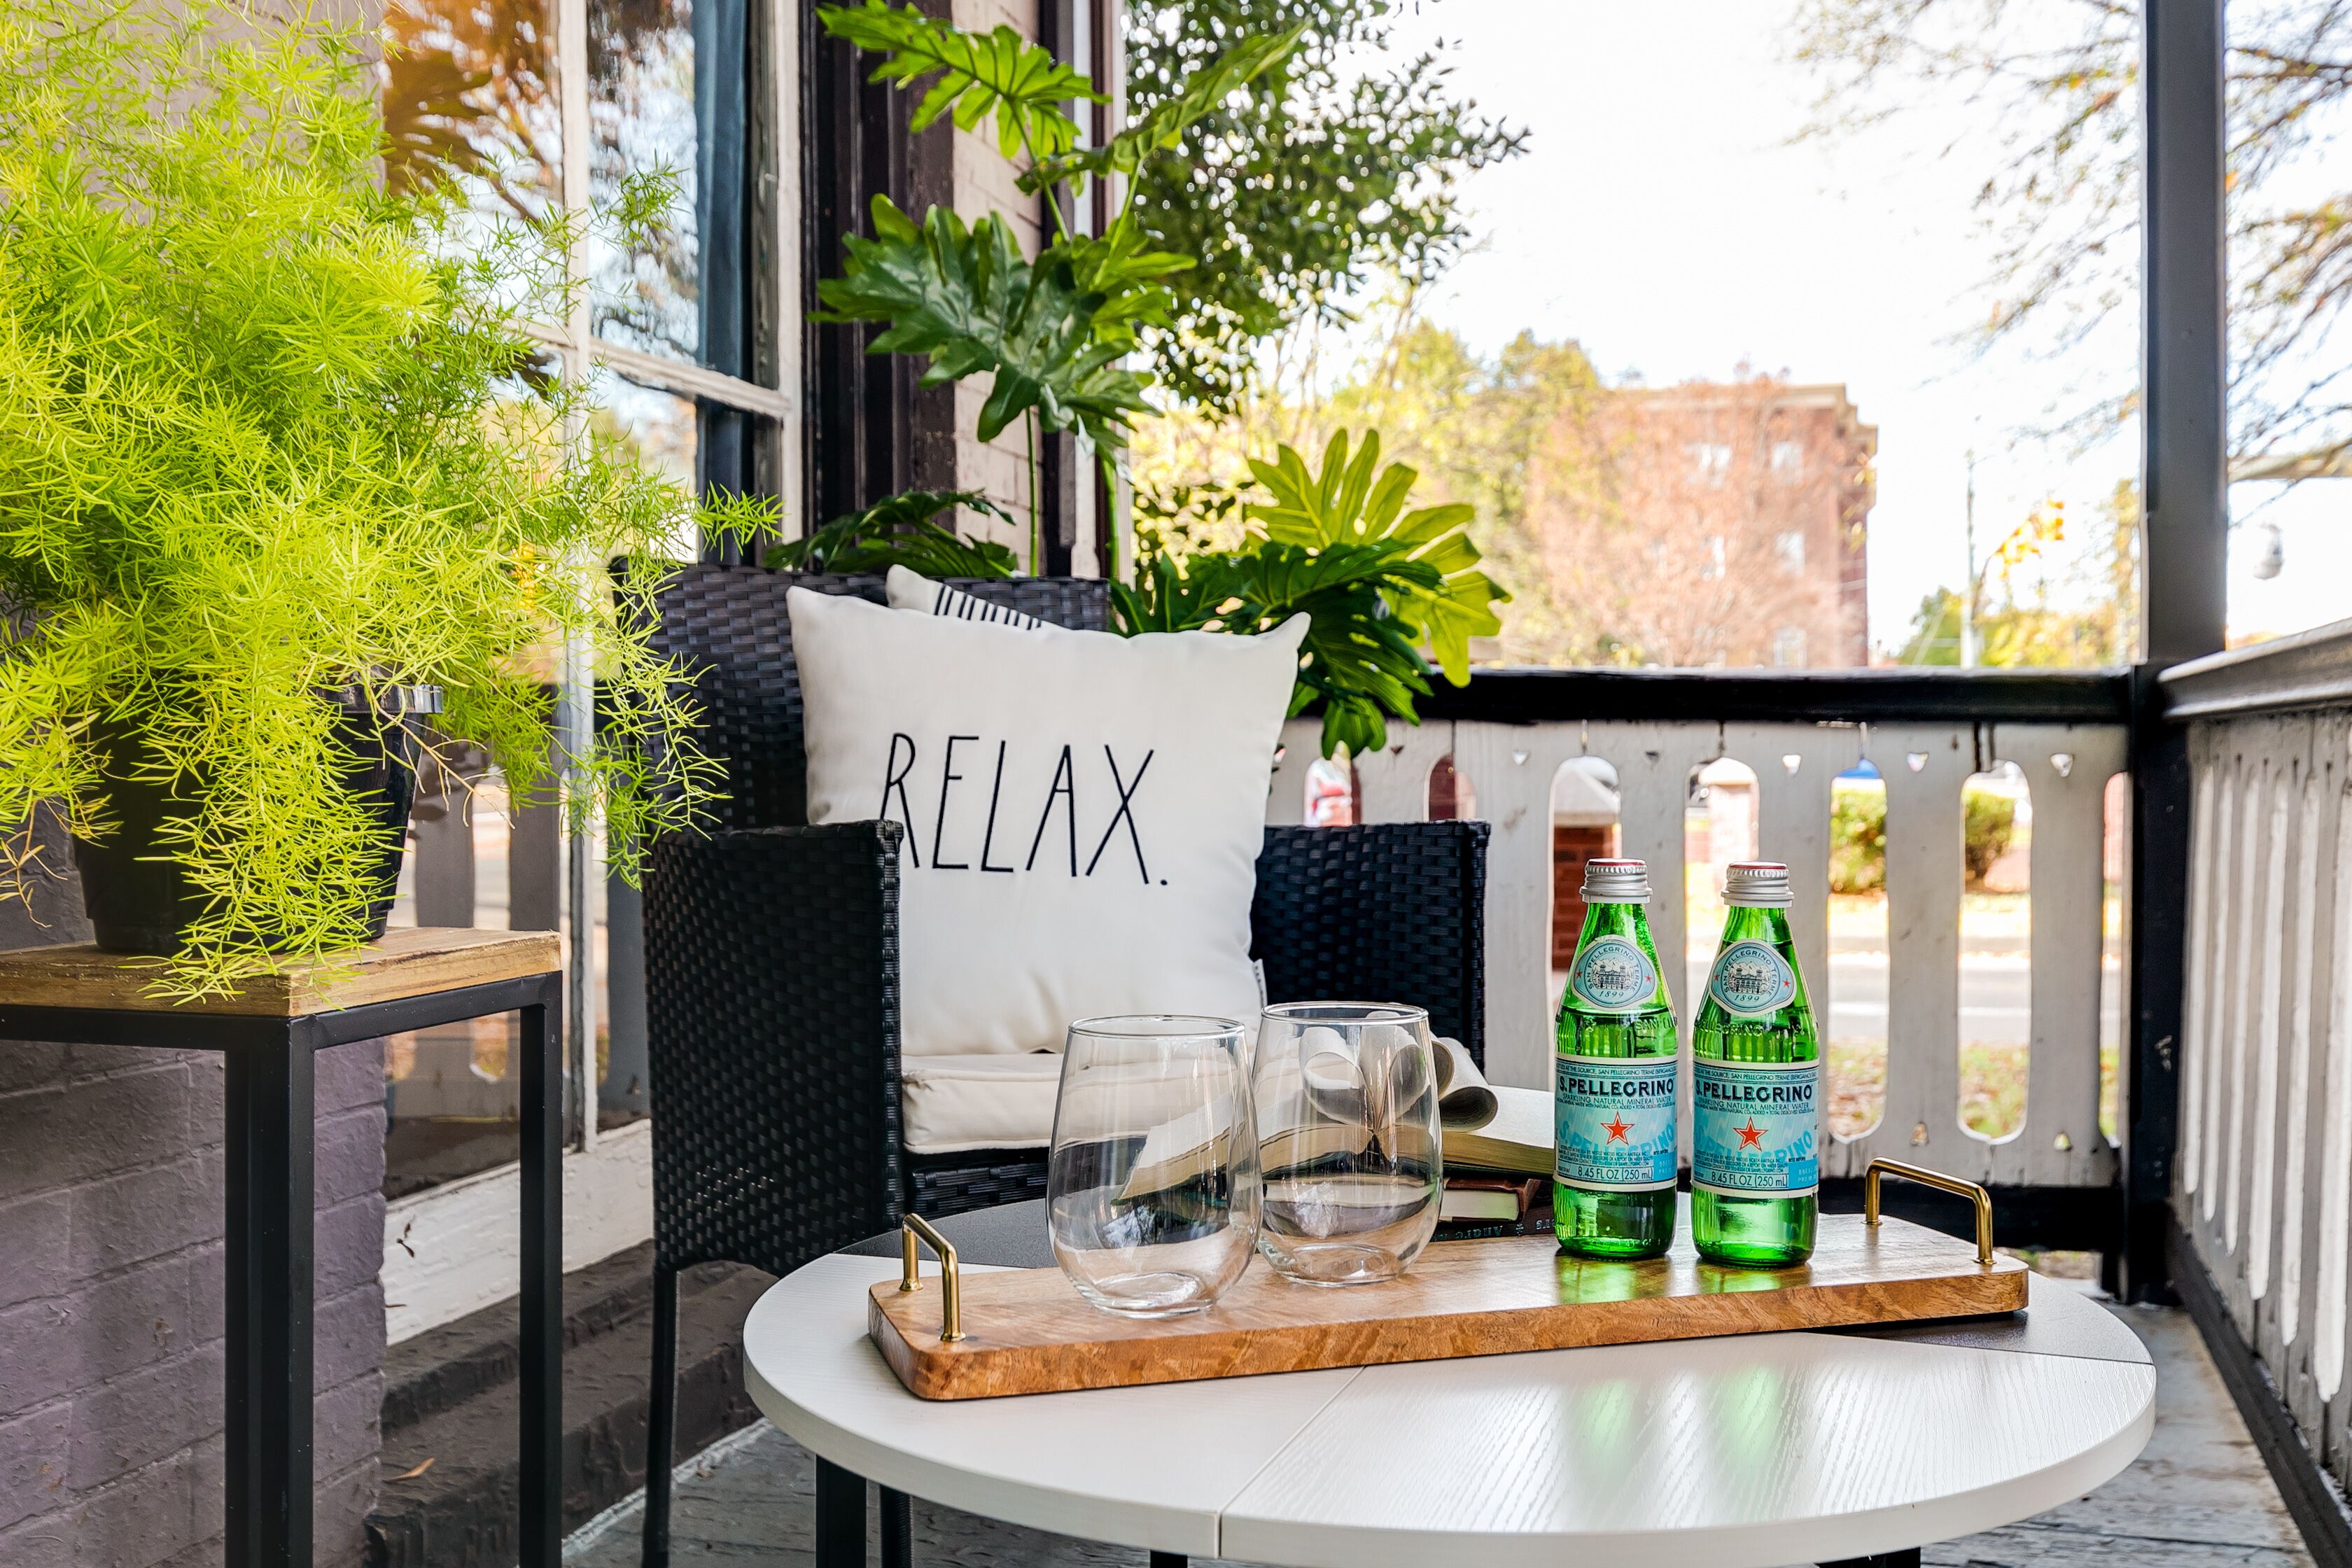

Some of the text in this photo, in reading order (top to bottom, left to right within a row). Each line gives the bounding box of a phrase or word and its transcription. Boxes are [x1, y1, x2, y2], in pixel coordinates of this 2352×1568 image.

[880, 732, 1168, 885] RELAX.
[1588, 946, 1634, 968] PELLEGRINO
[1630, 964, 1639, 991] TERME
[1725, 950, 1771, 972] PELLEGRINO
[1769, 968, 1777, 997] TERME
[1562, 1093, 1591, 1104] SPARKLING
[1727, 1102, 1757, 1110] NATURAL
[1578, 1166, 1594, 1177] 8.45
[1596, 1168, 1604, 1179] FL
[1606, 1169, 1619, 1180] OZ
[1622, 1168, 1639, 1180] (250
[1642, 1167, 1653, 1180] mL)
[1712, 1171, 1727, 1183] 8.45
[1729, 1174, 1737, 1184] FL
[1739, 1175, 1752, 1185] OZ
[1755, 1175, 1773, 1187] (250
[1775, 1175, 1788, 1187] mL)
